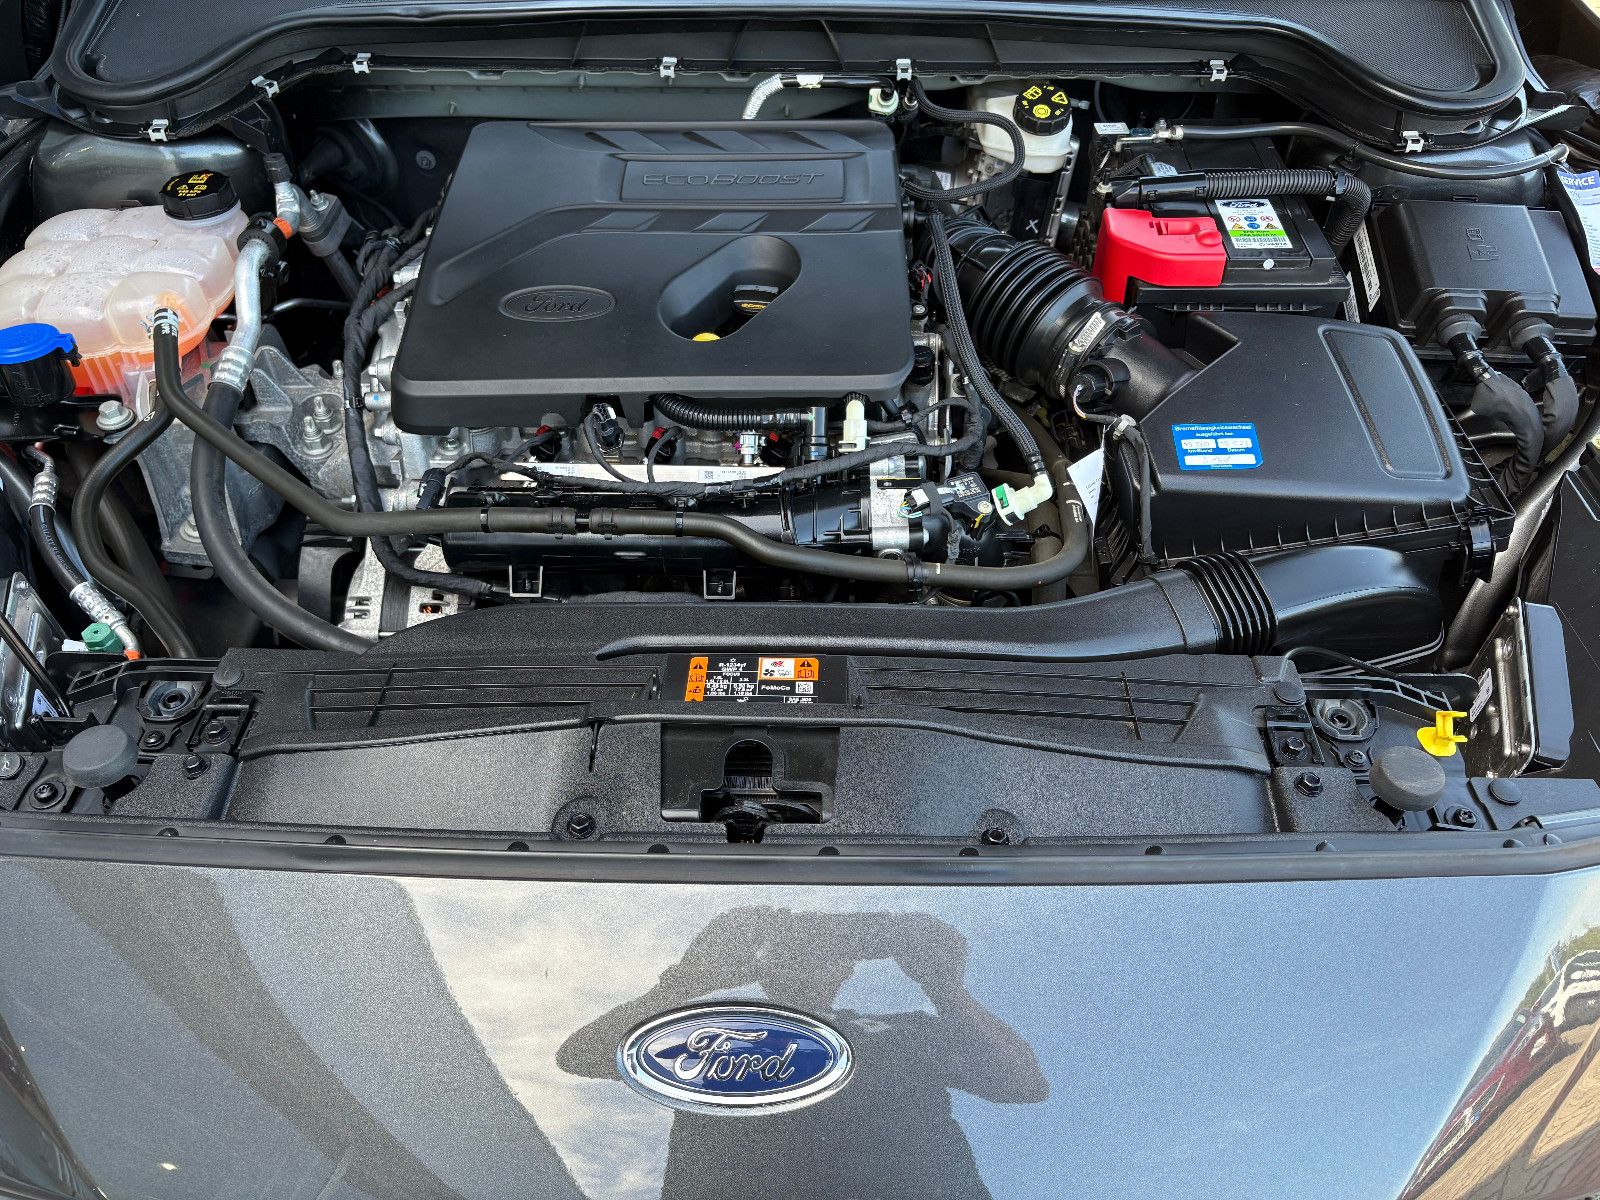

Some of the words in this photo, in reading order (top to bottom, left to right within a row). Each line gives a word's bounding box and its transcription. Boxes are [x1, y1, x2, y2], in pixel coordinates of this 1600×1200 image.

[642, 173, 823, 185] ECOBOOST
[1560, 176, 1595, 186] SERVICE
[524, 294, 590, 313] Ford
[673, 1027, 798, 1082] Ford
